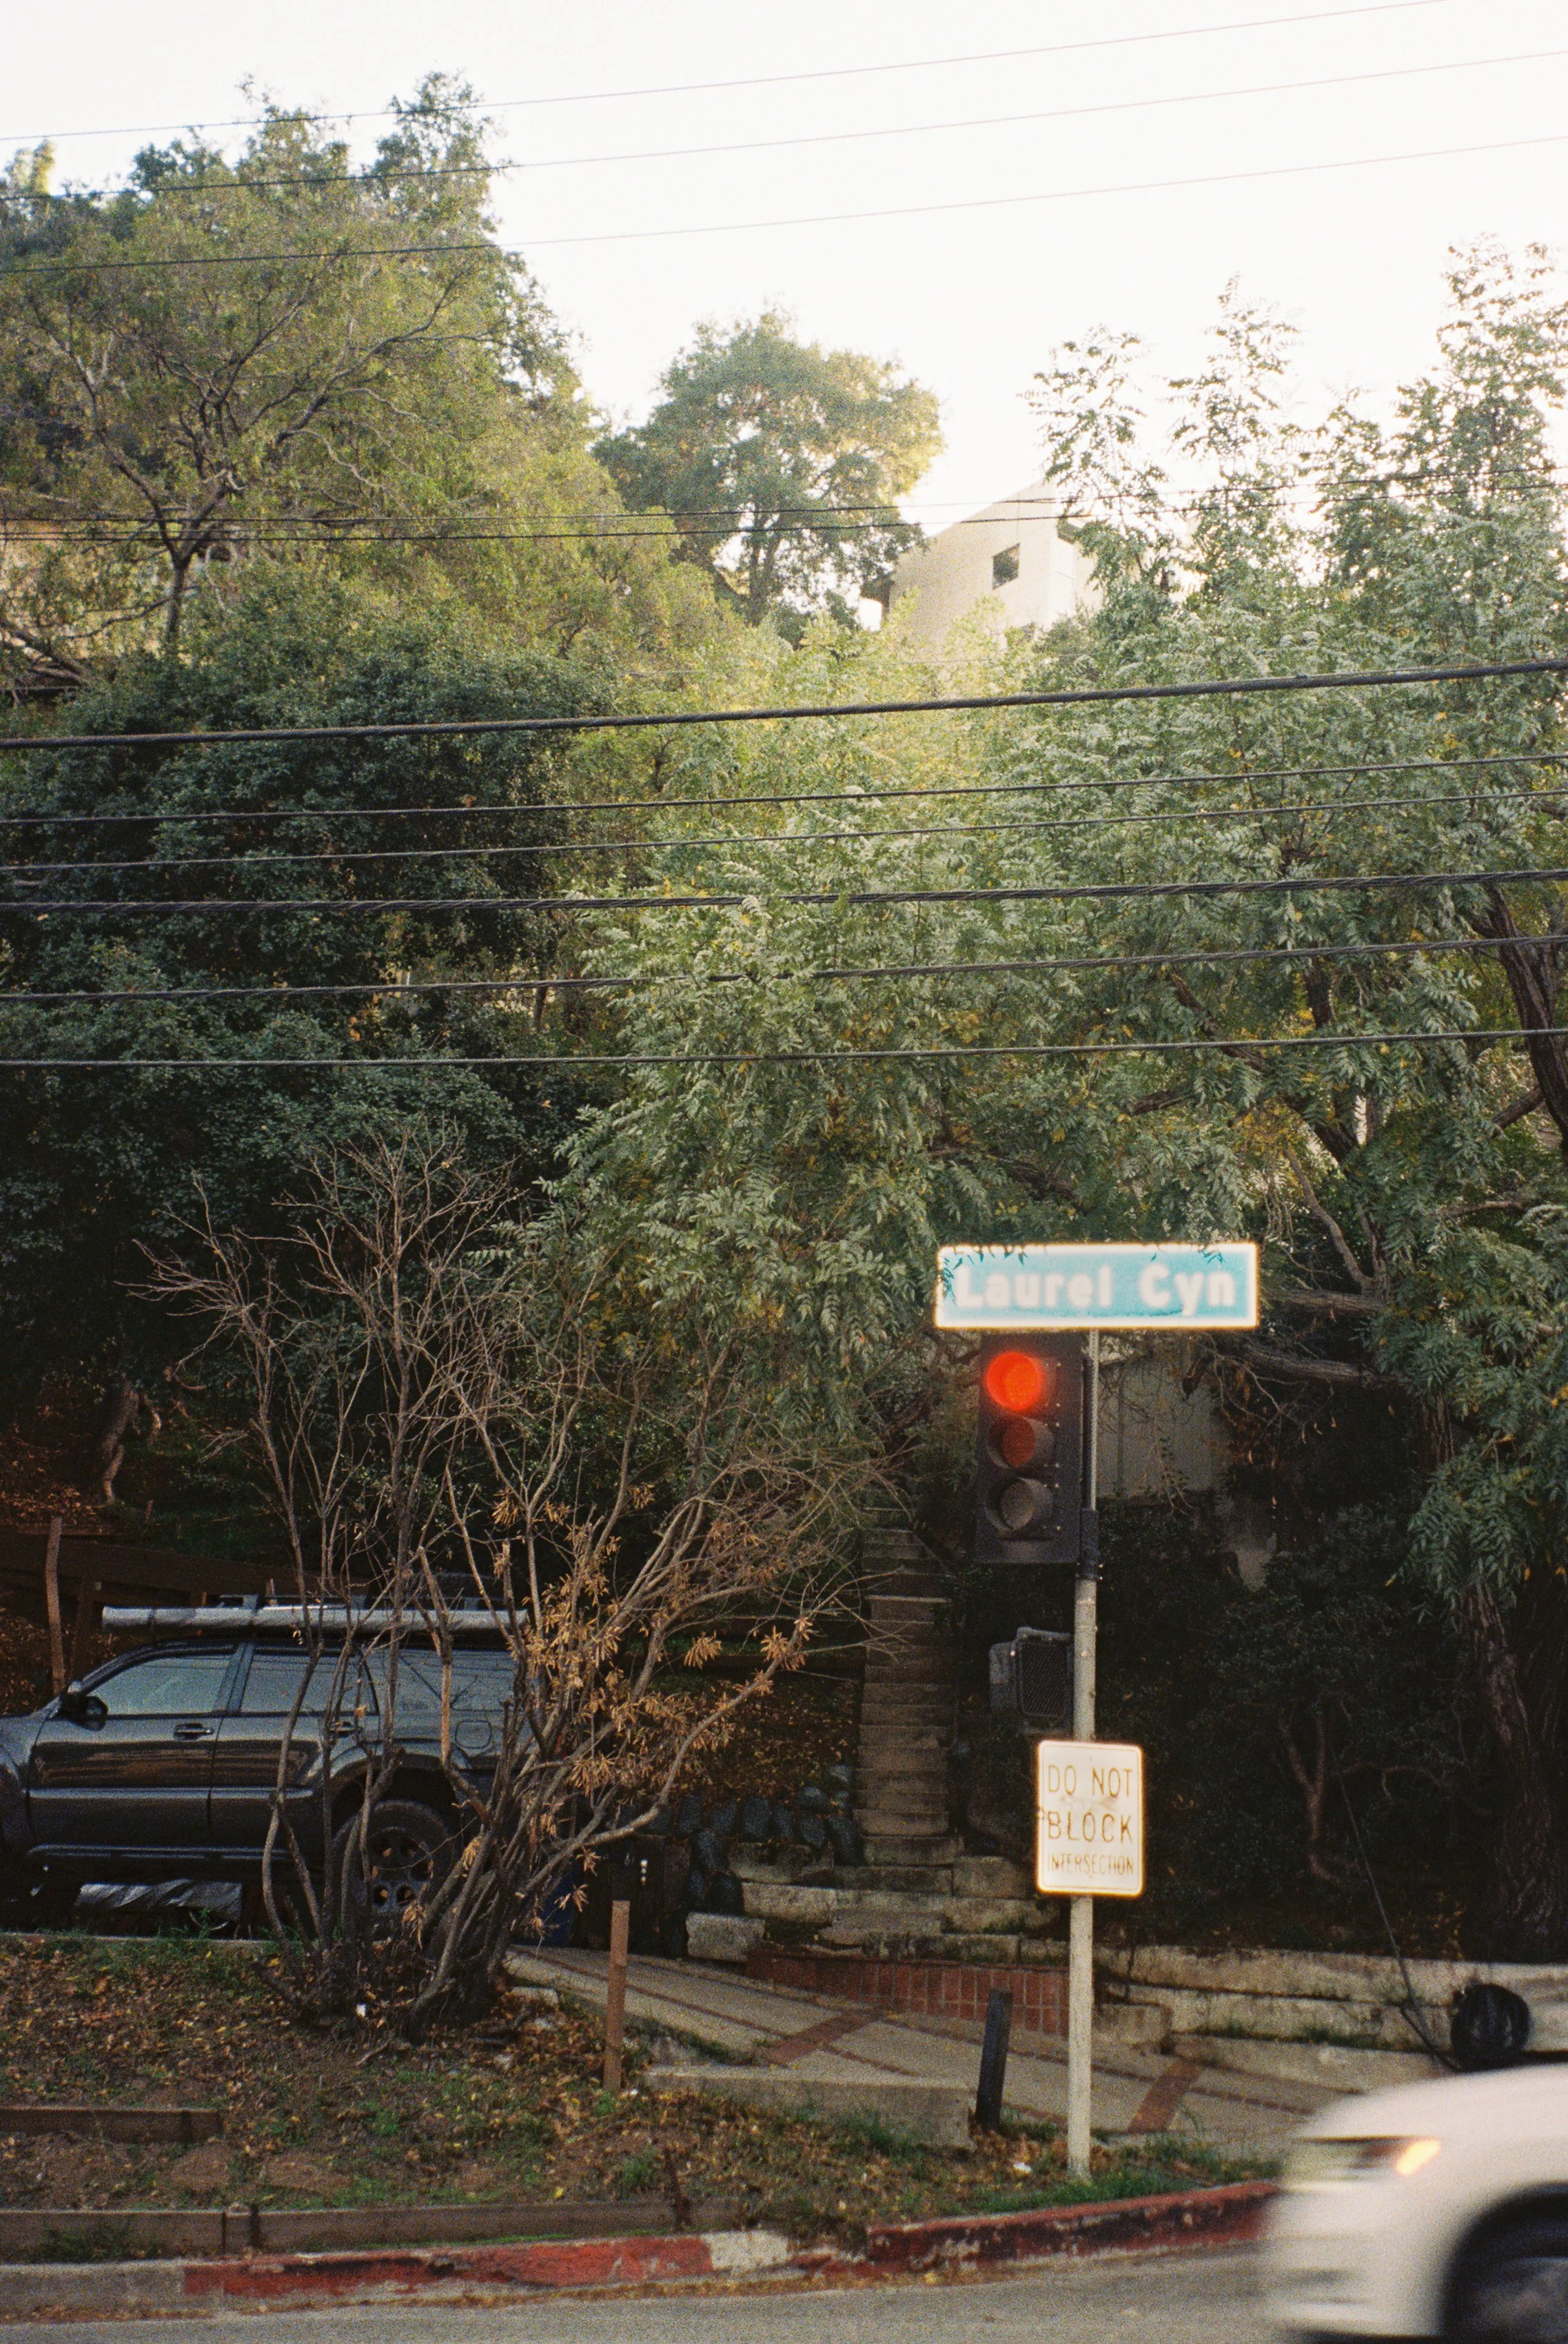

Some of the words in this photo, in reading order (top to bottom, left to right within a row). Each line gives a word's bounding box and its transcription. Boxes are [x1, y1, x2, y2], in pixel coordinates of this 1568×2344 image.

[956, 1264, 1111, 1308] Laurel
[1139, 1263, 1235, 1316] Cyn
[1048, 1764, 1077, 1795] DO
[1091, 1767, 1132, 1798] NOT
[1048, 1811, 1132, 1843] BLOCK
[1048, 1852, 1133, 1876] INTERSECTION
